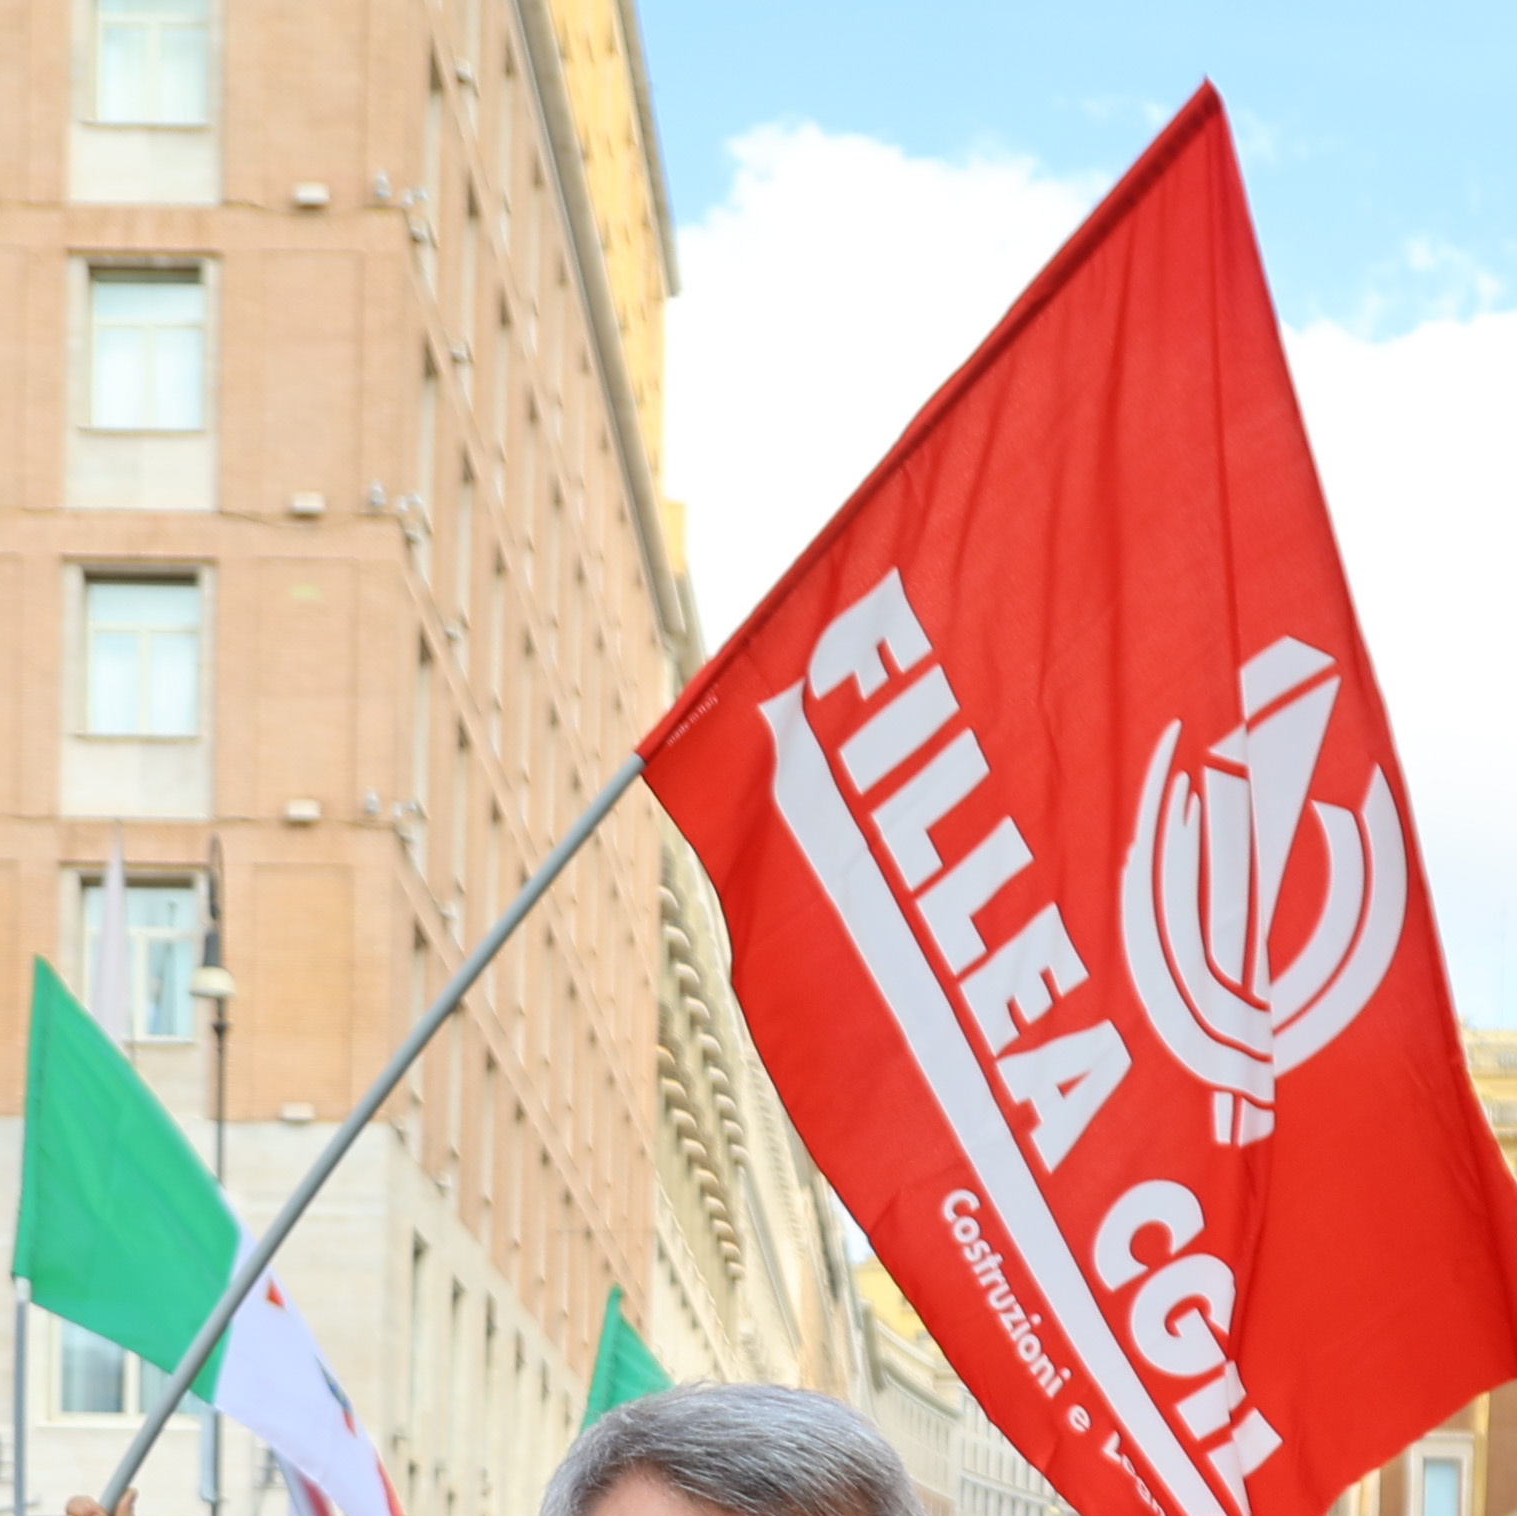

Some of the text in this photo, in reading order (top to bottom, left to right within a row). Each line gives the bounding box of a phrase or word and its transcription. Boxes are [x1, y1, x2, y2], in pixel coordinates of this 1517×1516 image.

[806, 565, 1133, 1173] FILLEA
[940, 1188, 1072, 1400] Costruzioni
[1066, 1403, 1092, 1434] e
